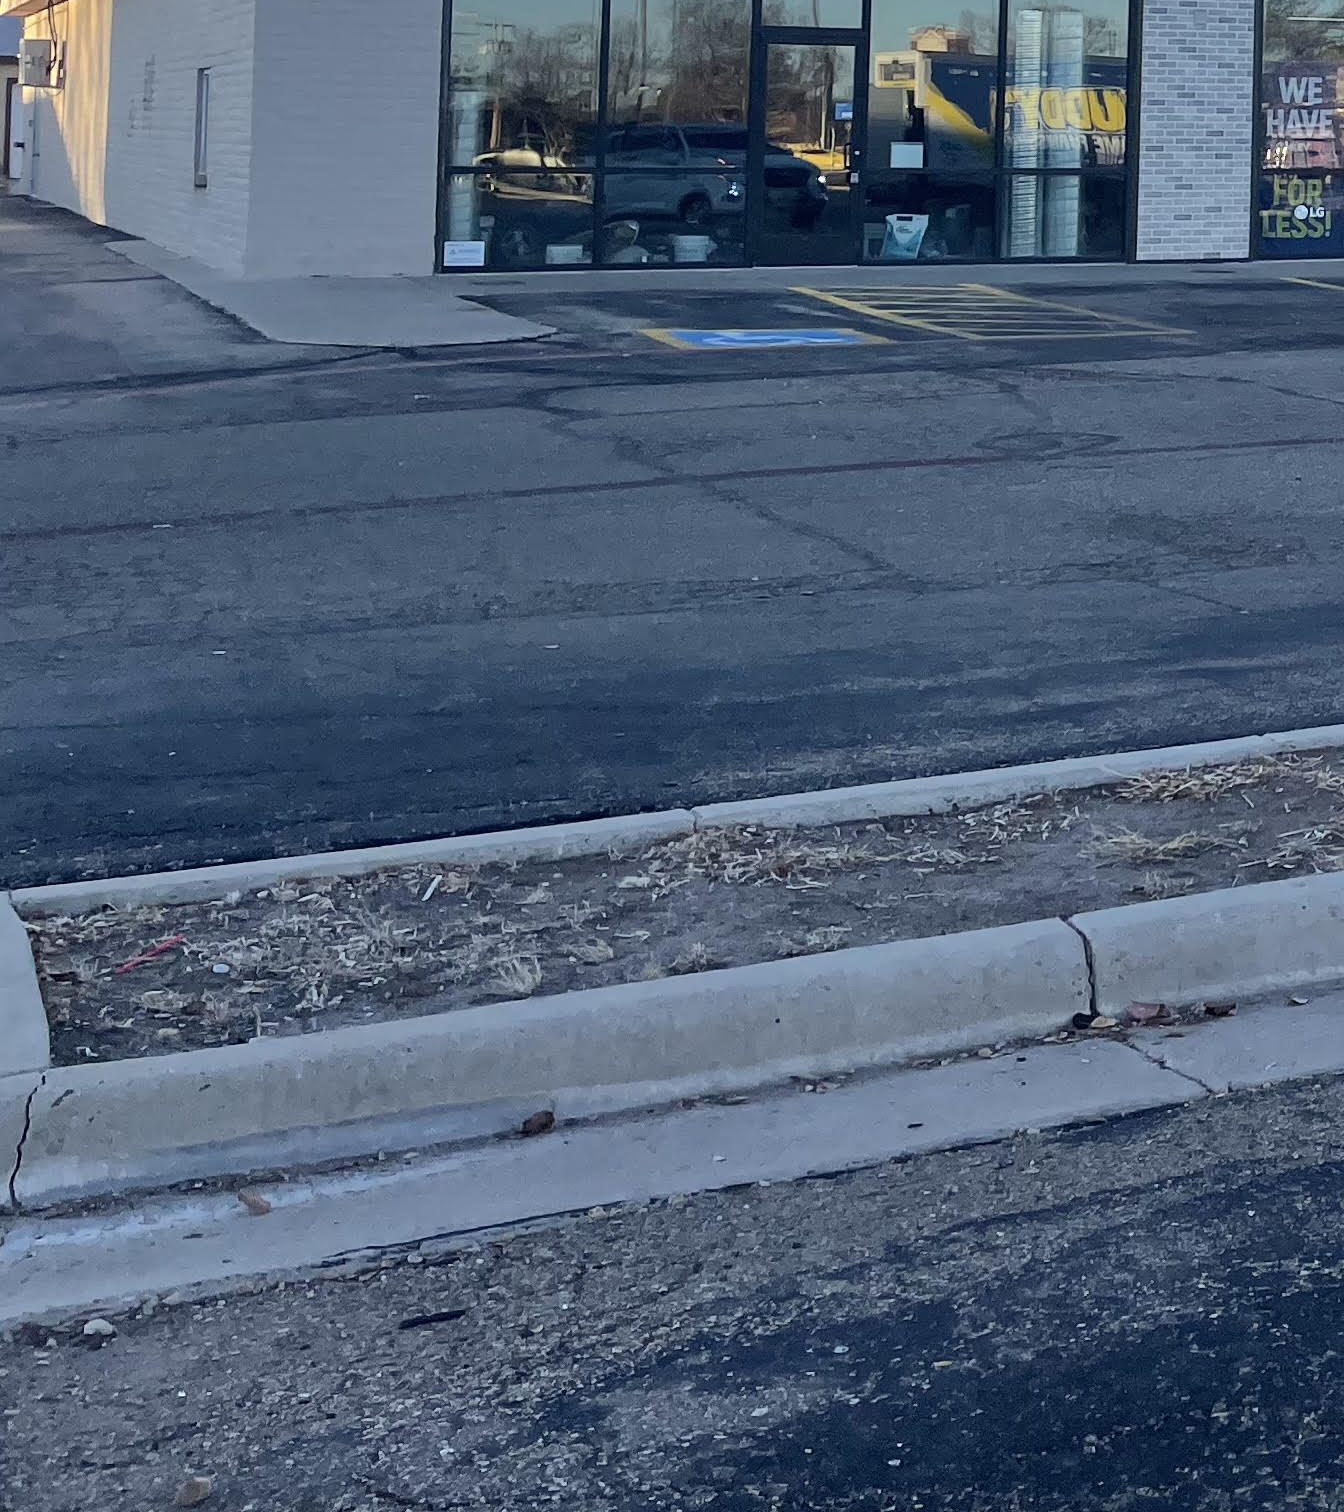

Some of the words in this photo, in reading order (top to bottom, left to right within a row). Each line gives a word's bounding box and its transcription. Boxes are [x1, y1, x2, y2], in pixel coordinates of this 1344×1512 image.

[1278, 76, 1324, 105] WE
[1266, 108, 1334, 138] HAVE
[1272, 174, 1323, 207] FOR
[1259, 209, 1332, 239] LESS!
